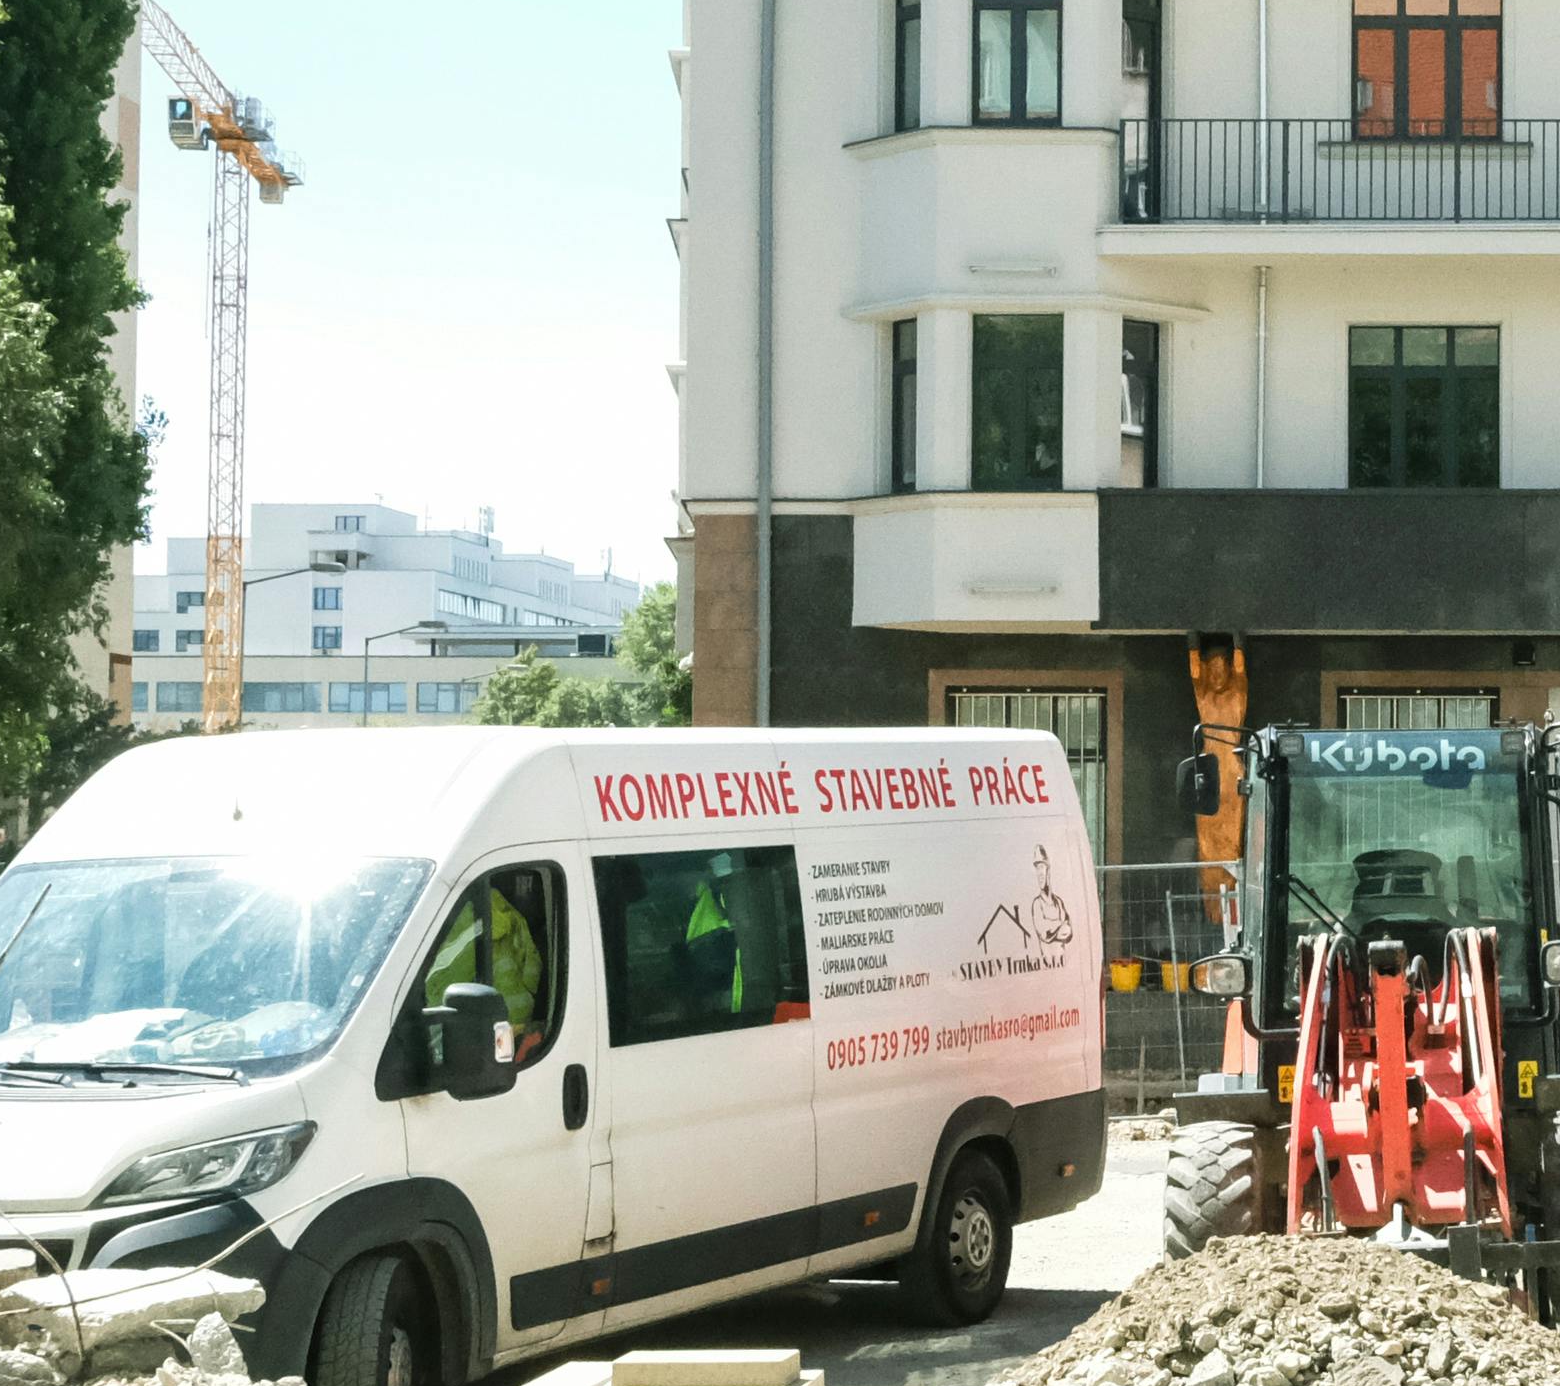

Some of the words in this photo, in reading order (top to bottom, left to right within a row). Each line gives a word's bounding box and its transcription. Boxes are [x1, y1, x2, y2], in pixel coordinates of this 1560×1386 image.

[1310, 739, 1485, 772] Kubota
[593, 761, 800, 822] KOMPLEXNÉ
[814, 758, 956, 812] STAVEBNÉ
[968, 757, 1050, 806] PRÁCE
[863, 860, 890, 875] STAVBY
[845, 883, 886, 900] VÝSTAVBA
[867, 903, 914, 922] RODINNÝCH
[915, 901, 944, 918] DOMOV
[869, 929, 894, 945] PRÁCE
[858, 954, 888, 970] OKOLIA
[960, 958, 1002, 981] STAVBY
[1007, 954, 1040, 975] Trnka
[867, 974, 897, 993] DLAŽBY
[899, 975, 905, 988] A
[906, 973, 930, 988] PLOTY
[827, 1036, 866, 1070] 0905
[871, 1031, 899, 1063] 739
[903, 1025, 930, 1058] 799
[936, 1004, 1080, 1052] stavbytrnkasro@gmail.com
